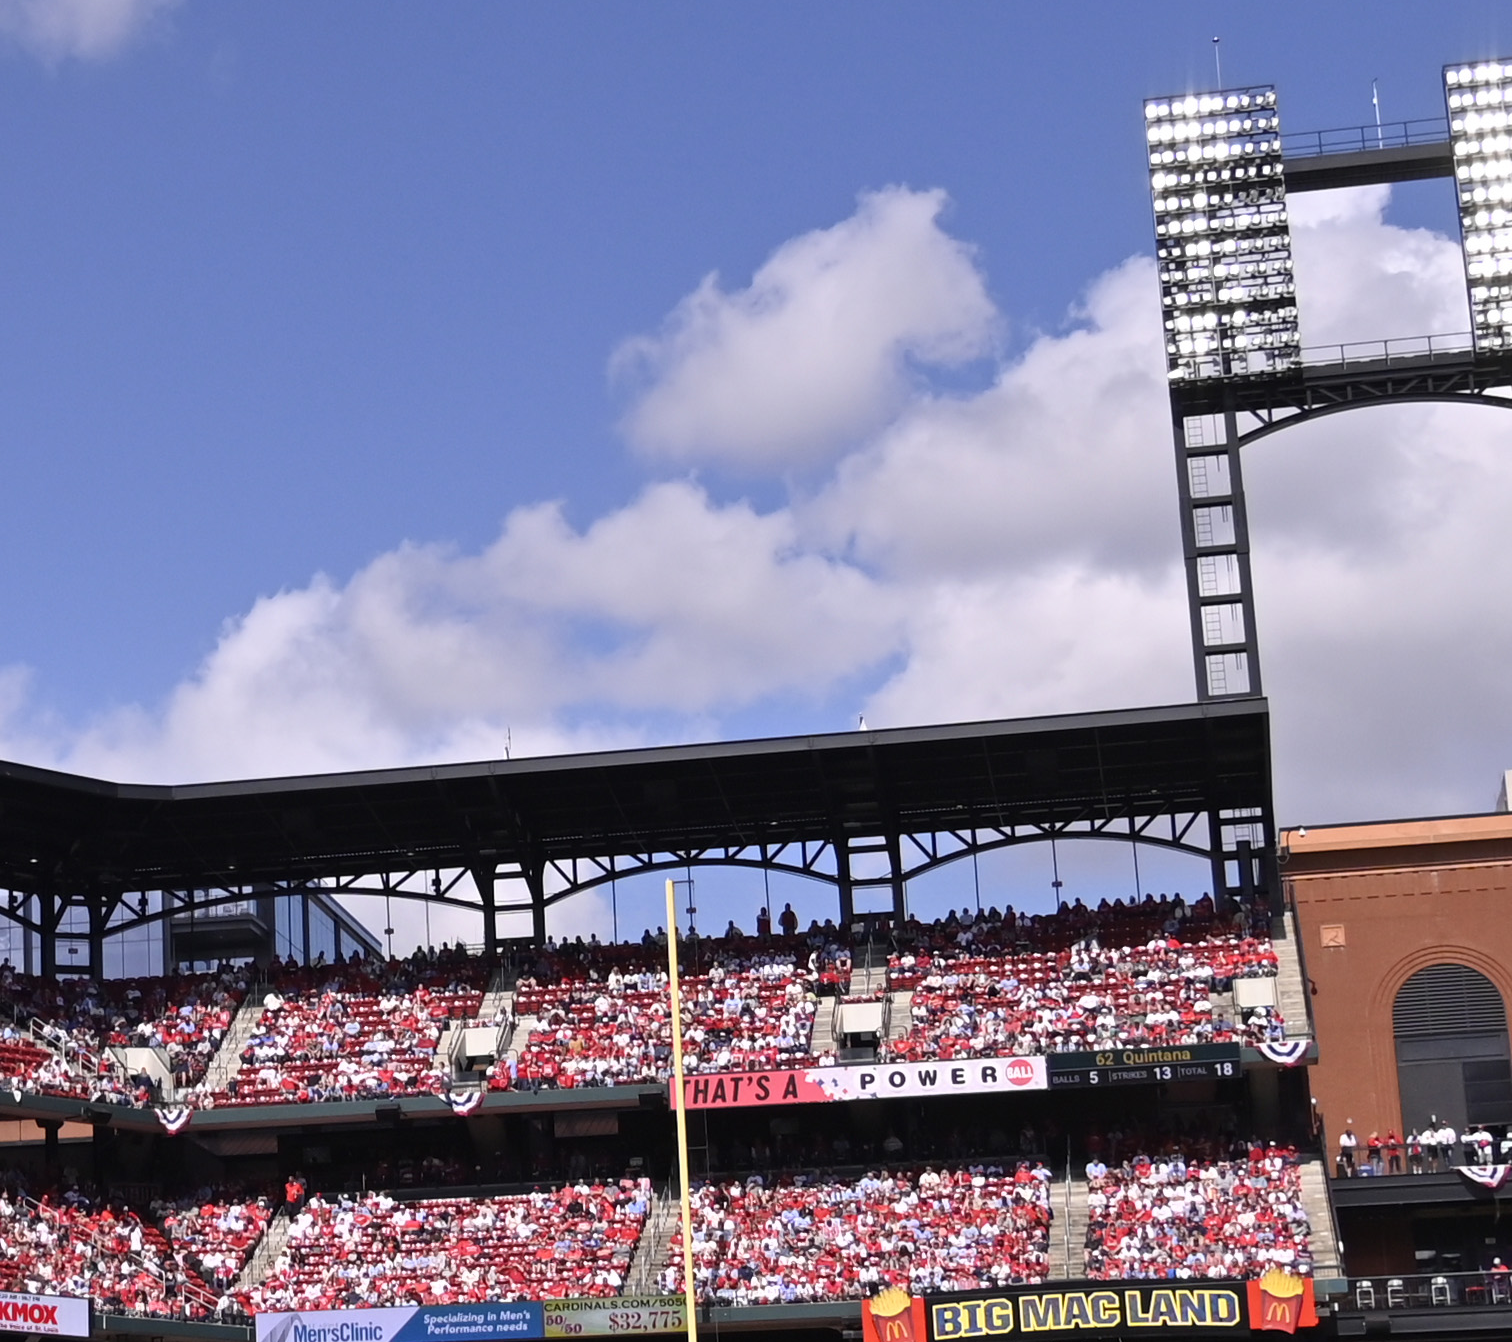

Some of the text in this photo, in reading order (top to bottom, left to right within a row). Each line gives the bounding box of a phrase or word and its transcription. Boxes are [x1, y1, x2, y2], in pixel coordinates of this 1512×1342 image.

[1095, 1048, 1191, 1066] 62 Quintana
[1005, 1065, 1034, 1079] BALL
[1089, 1070, 1099, 1085] 5
[1152, 1066, 1172, 1080] 13
[1180, 1066, 1207, 1076] TOTAL
[1214, 1062, 1234, 1076] 18
[782, 1074, 799, 1099] A
[423, 1310, 531, 1327] Specializing in Men's
[609, 1310, 682, 1333] $32,775
[932, 1289, 1241, 1340] BIG MAC LAND
[427, 1322, 528, 1336] Performance needs
